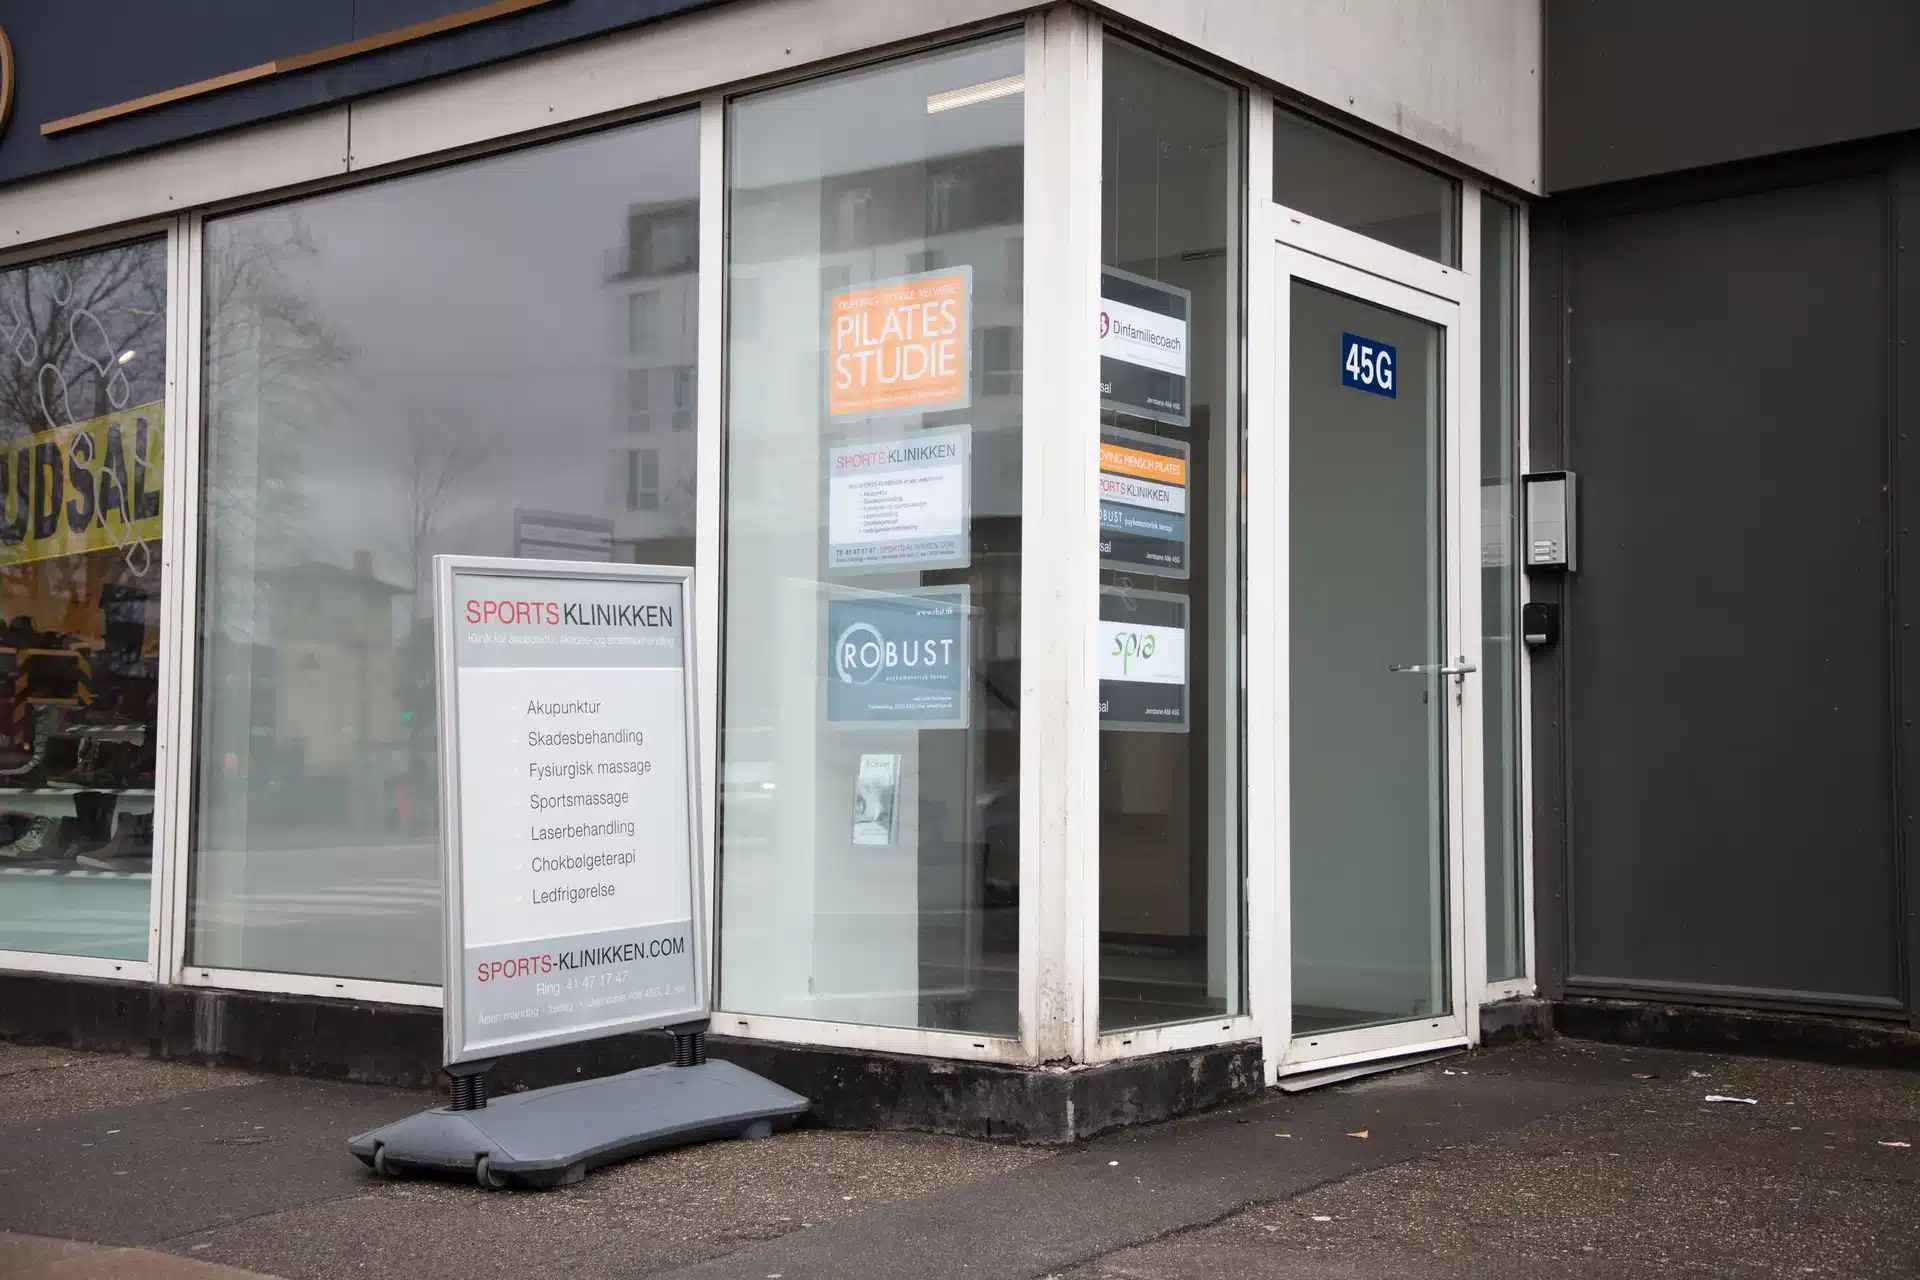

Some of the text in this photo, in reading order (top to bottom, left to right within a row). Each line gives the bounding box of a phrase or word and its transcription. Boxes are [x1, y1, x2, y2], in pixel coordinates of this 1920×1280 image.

[837, 298, 956, 350] PILATES
[1113, 320, 1181, 351] Dinfamiliecoach
[836, 338, 956, 389] STUDIE
[1346, 343, 1392, 390] 45G
[1124, 455, 1153, 471] MENSCH
[1155, 461, 1181, 476] PILATES
[0, 416, 160, 546] UDSAL
[1100, 541, 1112, 552] sal
[844, 639, 953, 669] ROBUST
[527, 700, 602, 717] Akupunktur
[528, 729, 644, 747] Skadesbehandling
[529, 760, 652, 780] Fysiurgisk massage
[530, 791, 629, 812] Sportsmassage
[531, 820, 636, 841] Laserbehandling
[531, 849, 636, 873] Chokbølgeterapi
[533, 883, 616, 904] Ledfrigørelse
[477, 936, 686, 983] SPORTS-KLINIKKEN.COM
[536, 970, 629, 997] Ring 41 47 17 47
